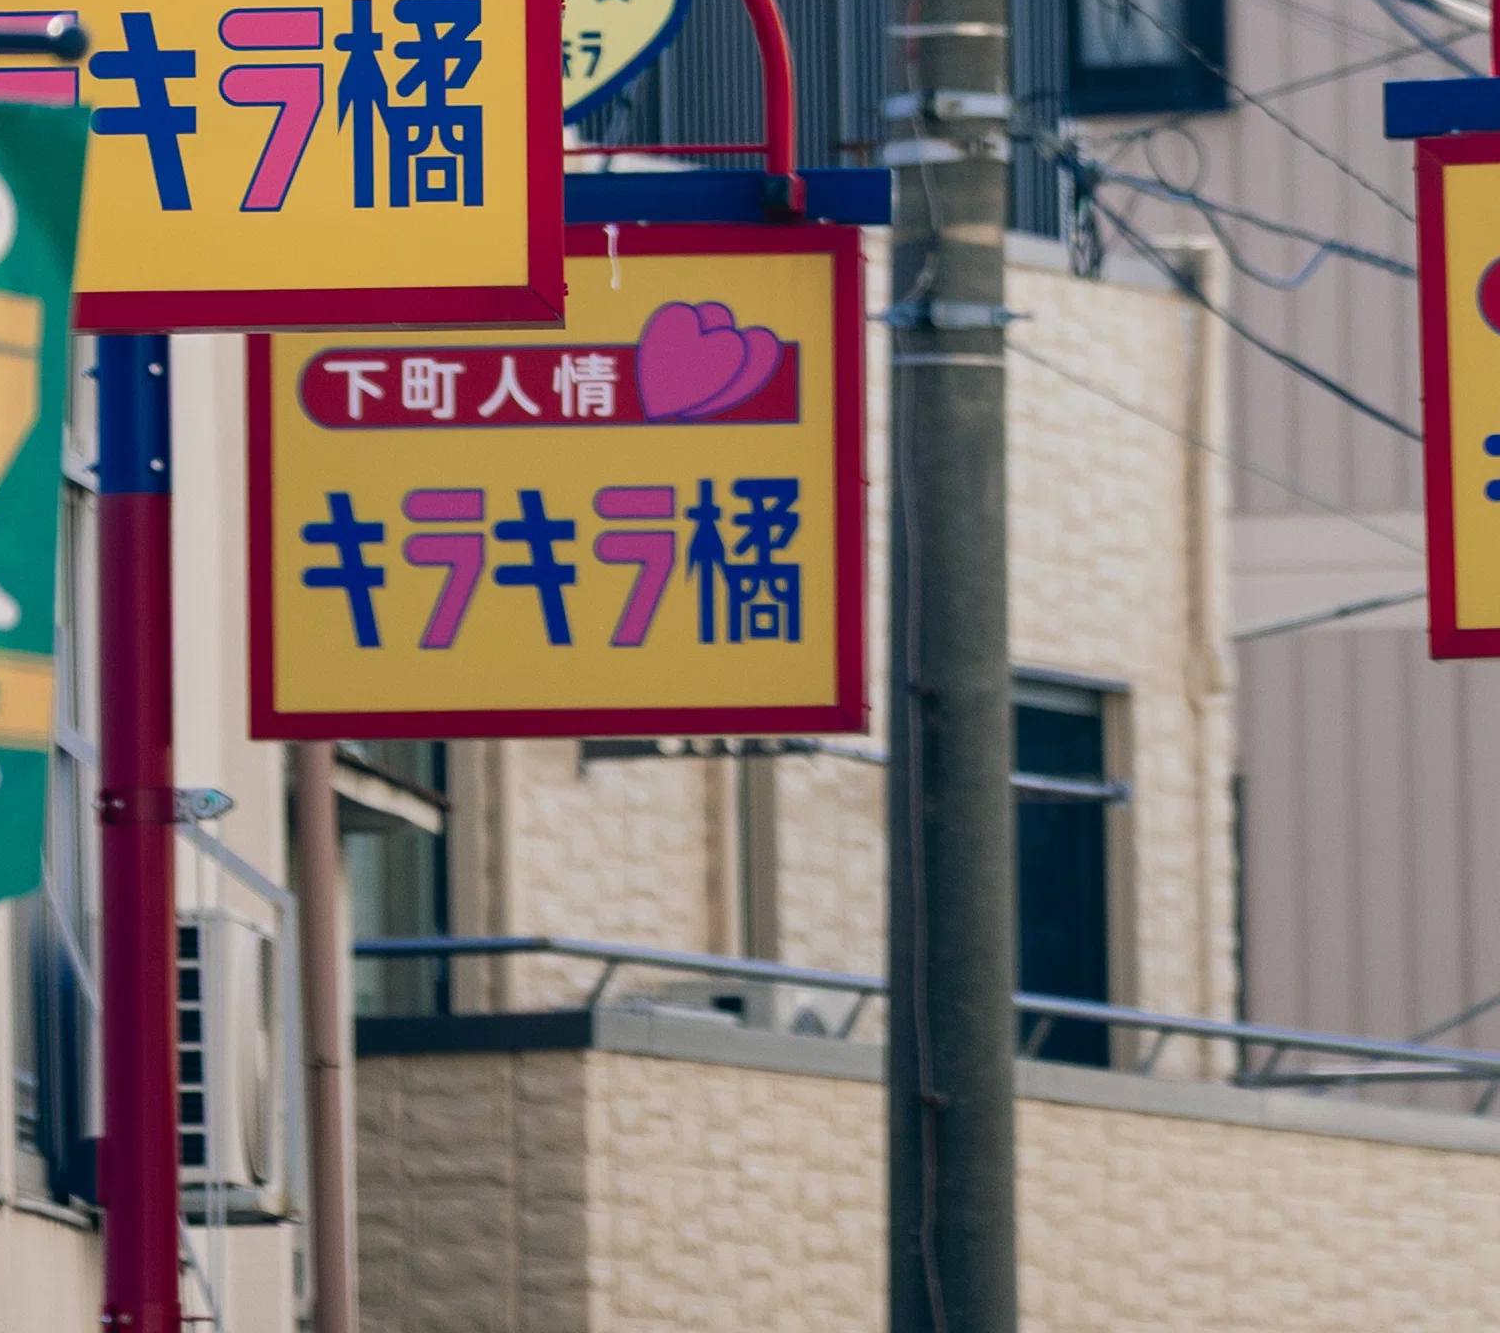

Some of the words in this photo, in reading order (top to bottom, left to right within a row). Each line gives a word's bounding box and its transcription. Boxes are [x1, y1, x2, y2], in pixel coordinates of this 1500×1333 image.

[323, 355, 621, 421] 下町人情
[300, 475, 804, 652] キラキラ橘
